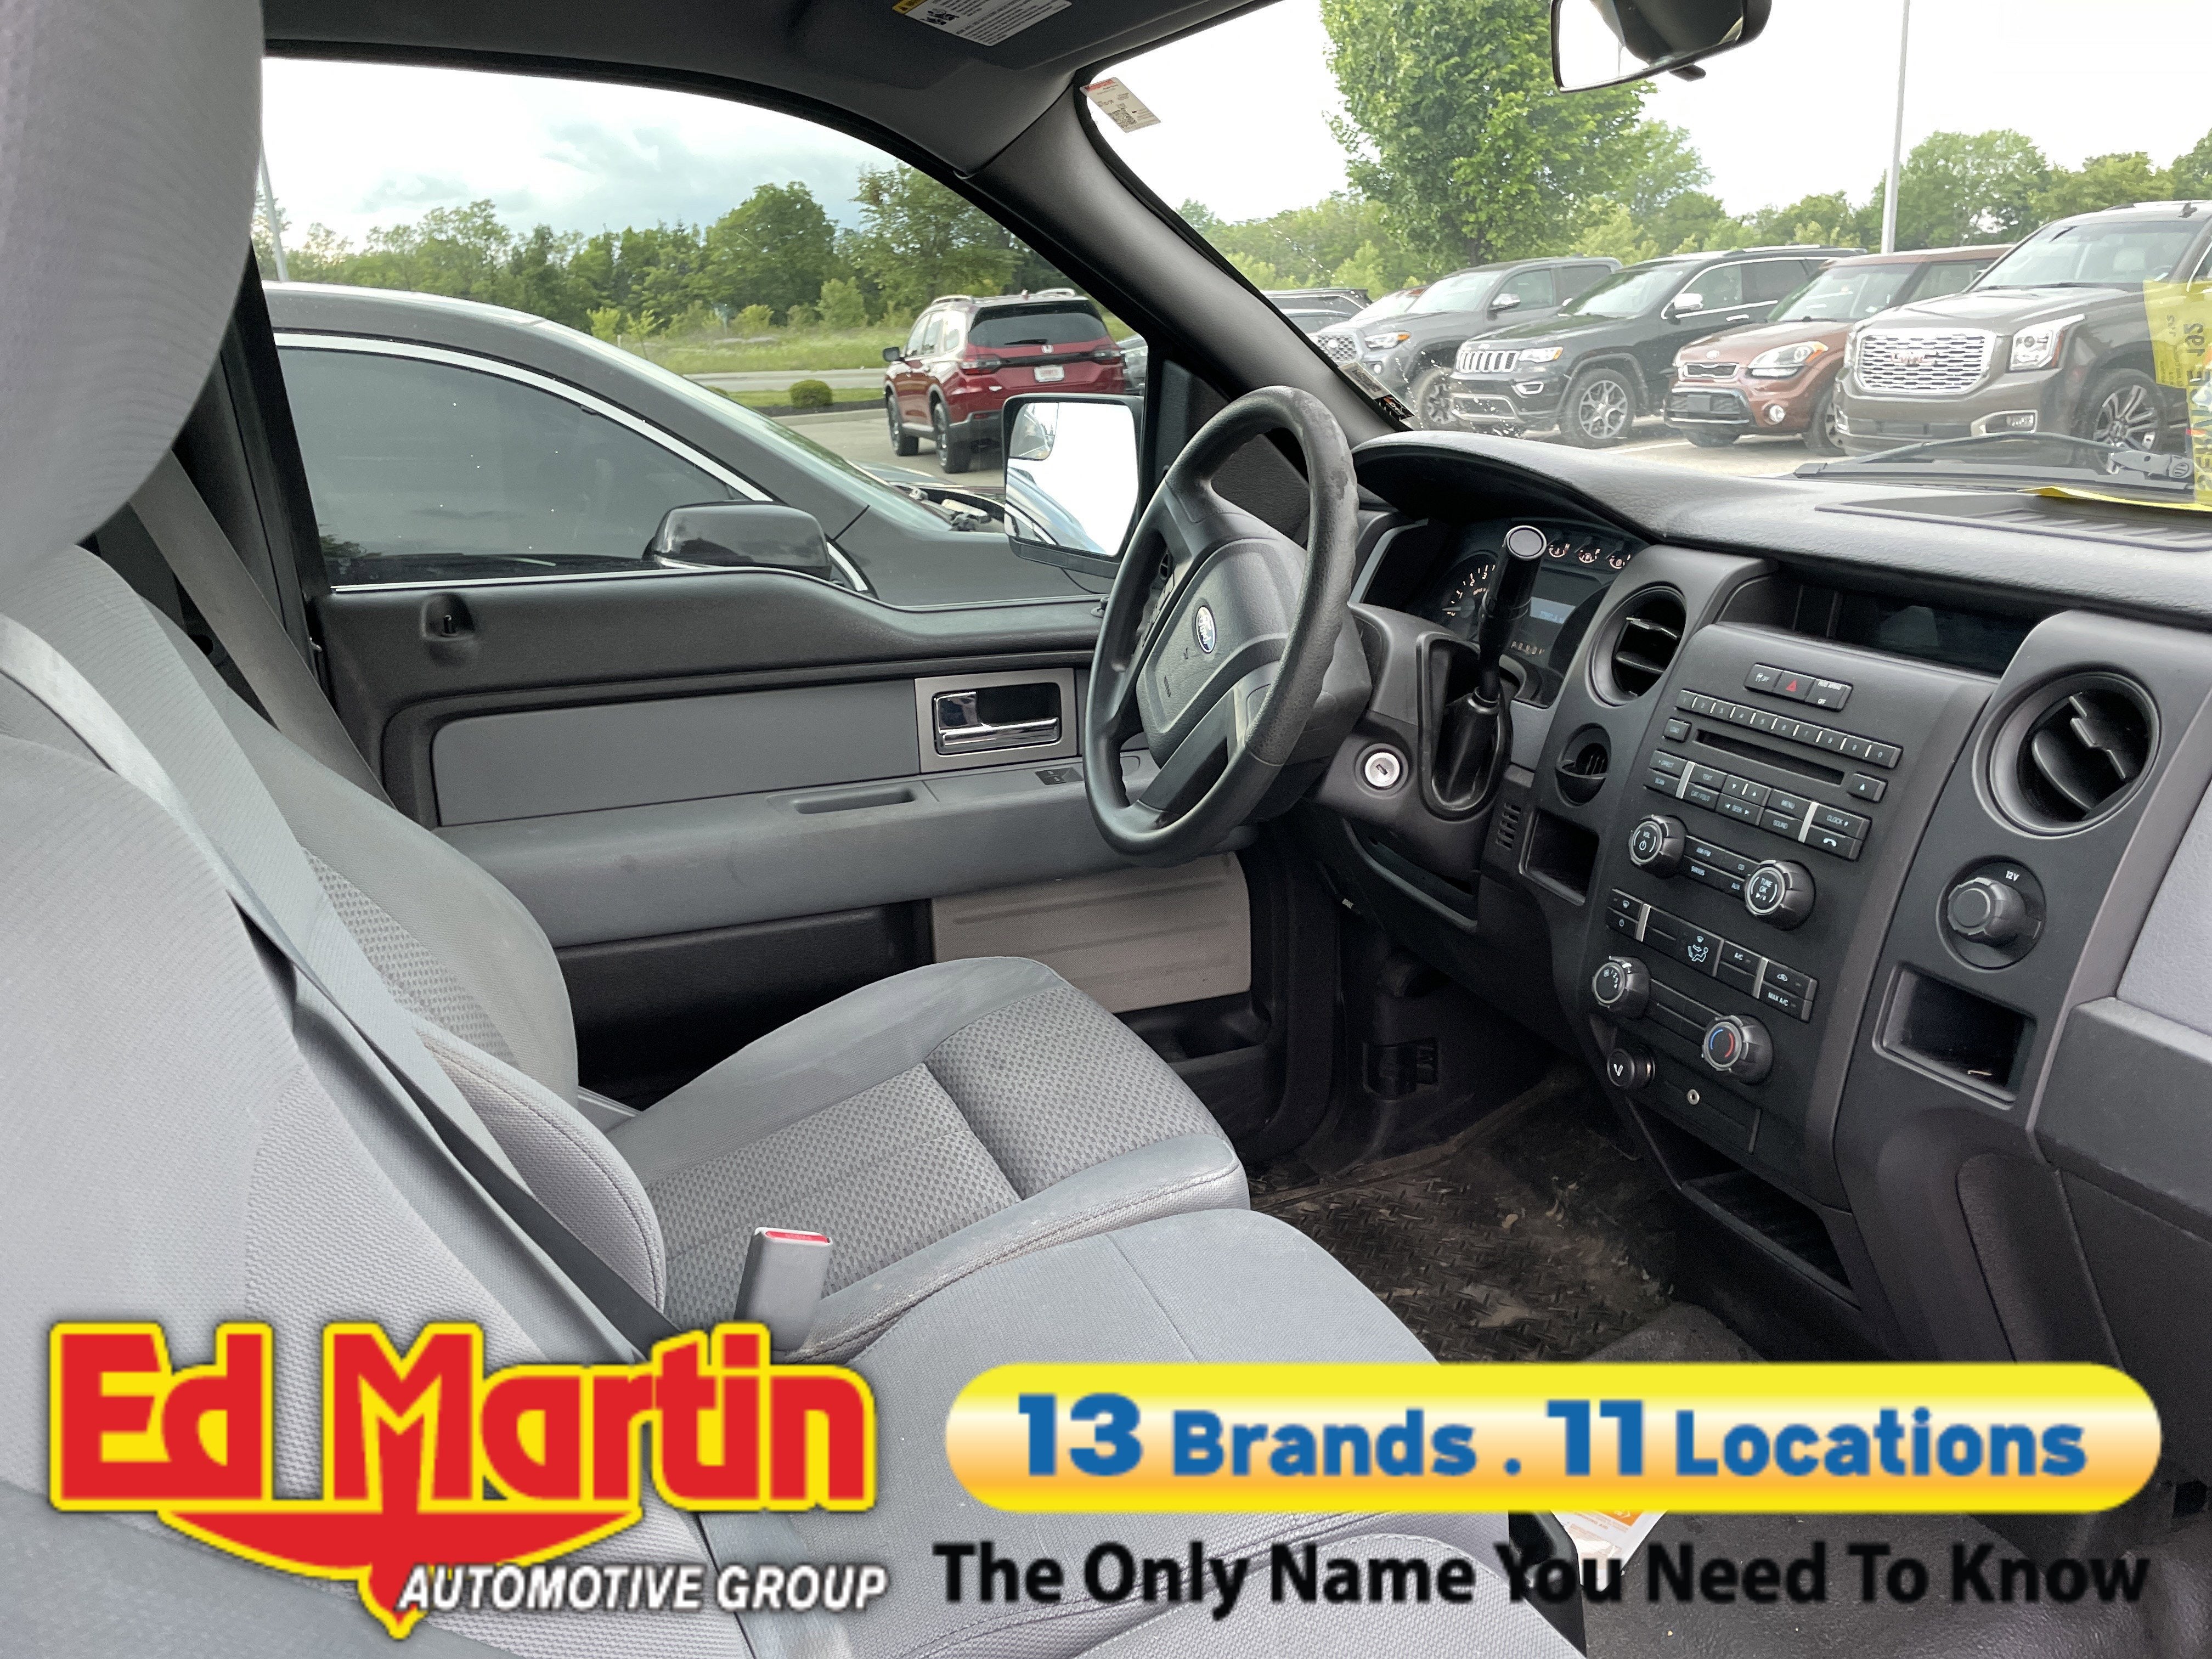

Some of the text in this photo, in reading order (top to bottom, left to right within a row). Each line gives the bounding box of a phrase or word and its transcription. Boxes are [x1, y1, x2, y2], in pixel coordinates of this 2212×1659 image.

[1781, 799, 1796, 809] MENU
[1772, 820, 1788, 830] SOUND
[1826, 815, 1843, 825] CLOCK
[2005, 870, 2019, 882] 12V
[1760, 877, 1773, 888] TUNE
[1759, 885, 1768, 894] OK
[1768, 992, 1788, 1007] MAX A/C
